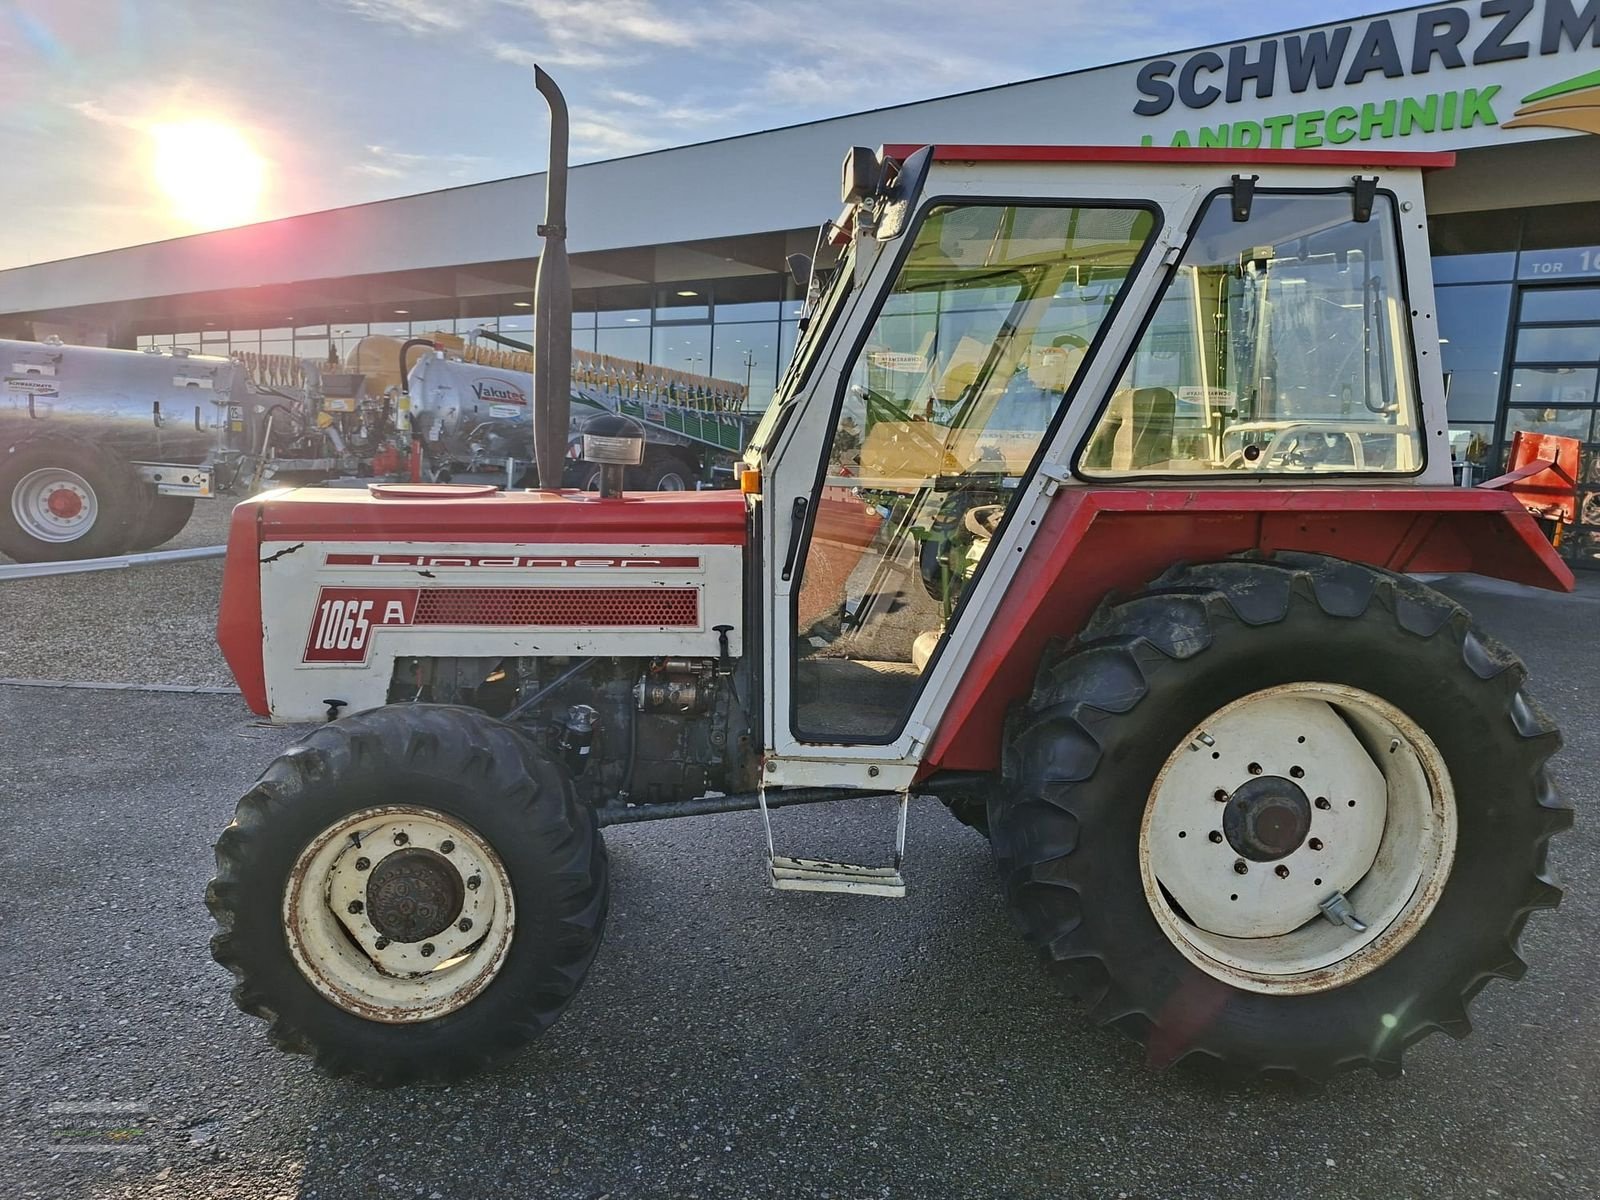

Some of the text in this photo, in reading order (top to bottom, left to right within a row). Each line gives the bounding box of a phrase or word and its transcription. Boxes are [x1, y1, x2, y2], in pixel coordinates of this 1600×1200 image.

[1532, 262, 1563, 273] TOR
[471, 382, 527, 402] Vakutec
[372, 555, 660, 567] Lindner
[315, 600, 405, 650] 1065 A
